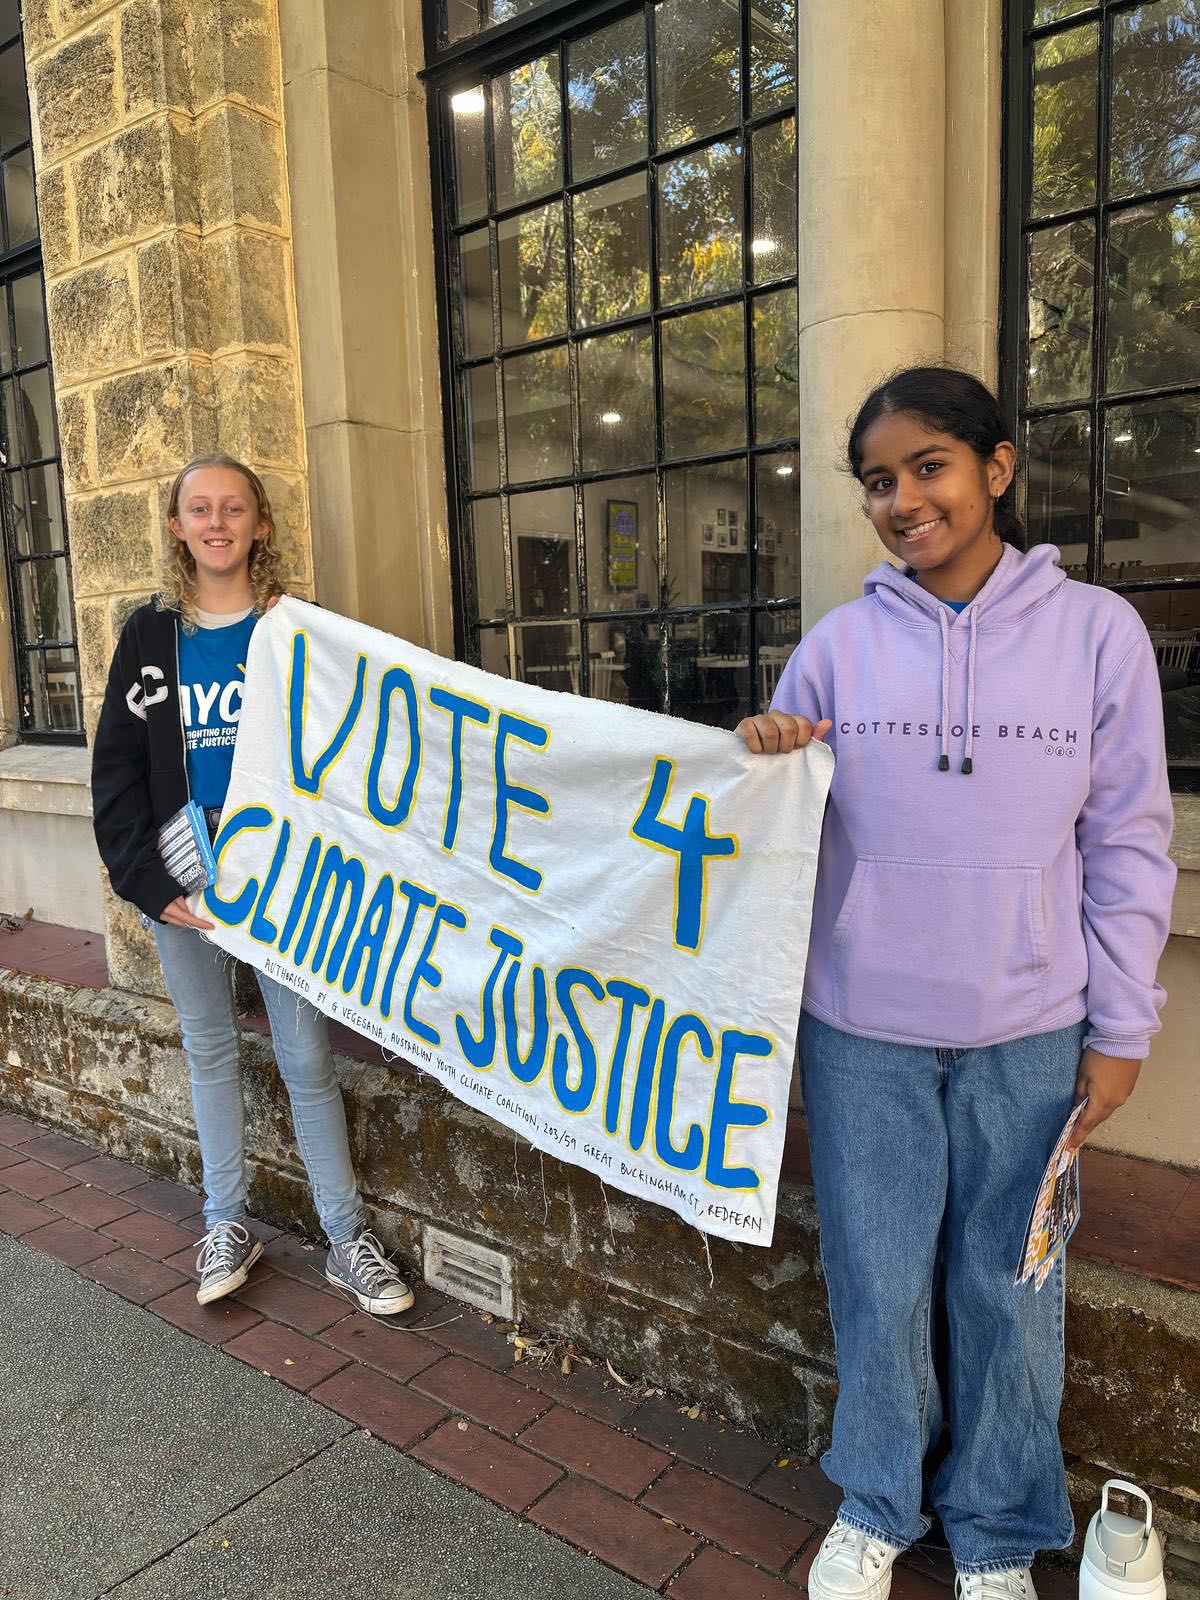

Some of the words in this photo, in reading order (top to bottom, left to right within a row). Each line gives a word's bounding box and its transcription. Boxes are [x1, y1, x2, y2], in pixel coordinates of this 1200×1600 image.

[199, 736, 237, 748] JUSTICE
[221, 726, 237, 736] FOR
[289, 630, 550, 894] VOTE
[631, 755, 739, 955] 4
[840, 721, 981, 738] COTTESLOE
[998, 725, 1077, 743] BEACH
[201, 803, 469, 1047] CLIMATE
[456, 925, 778, 1191] JUSTICE
[264, 958, 310, 993] AUTHORISED
[316, 991, 327, 1004] BY
[331, 1001, 338, 1013] G
[342, 1007, 387, 1044] VEGESANA,
[390, 1032, 432, 1063] AUSTRALIAN
[436, 1057, 456, 1080] YOUTH
[460, 1074, 494, 1100] CLIMATE
[496, 1094, 540, 1132] COALITION,
[543, 1122, 577, 1150] 203/59
[583, 1143, 613, 1168] GREAT
[707, 1204, 763, 1233] REDFERN
